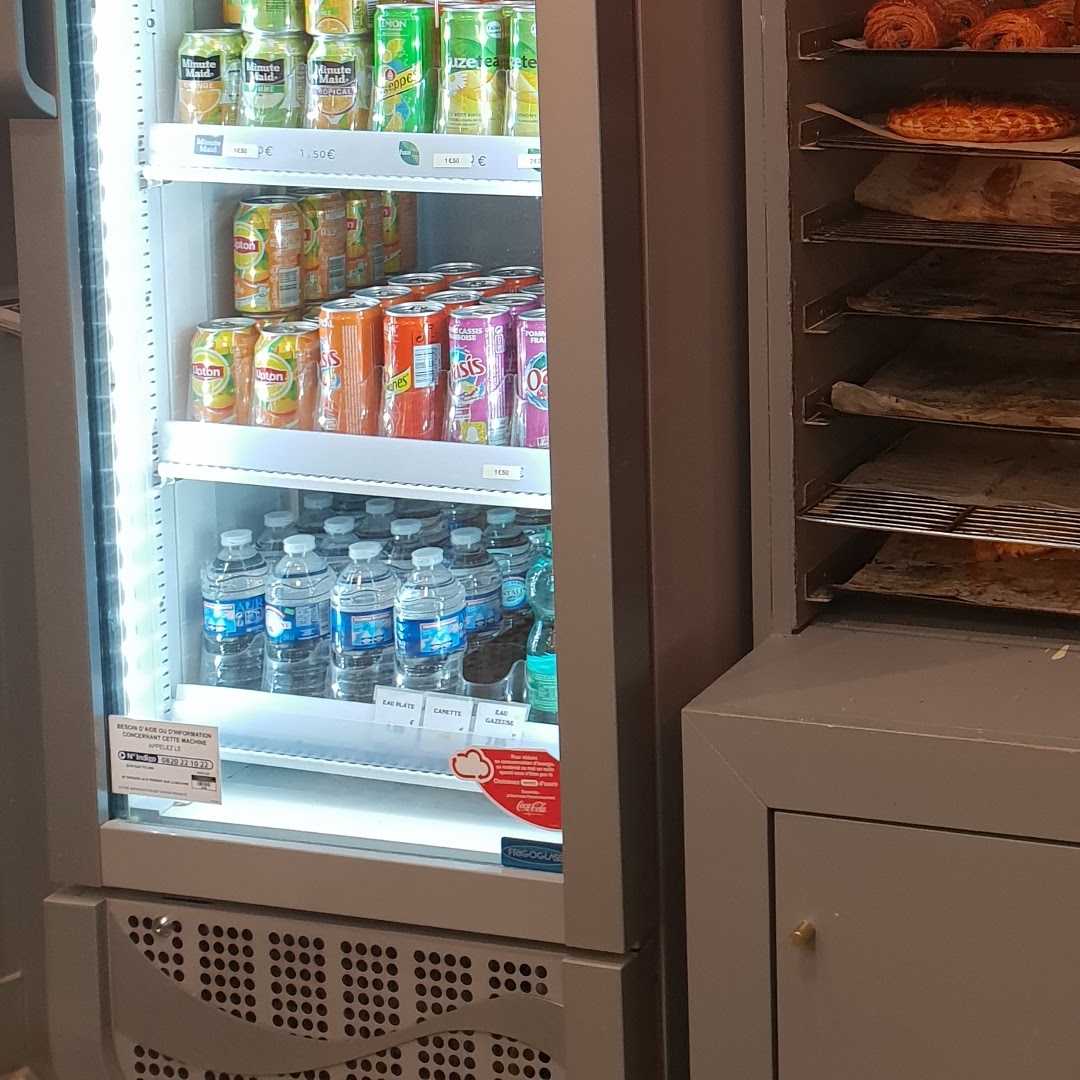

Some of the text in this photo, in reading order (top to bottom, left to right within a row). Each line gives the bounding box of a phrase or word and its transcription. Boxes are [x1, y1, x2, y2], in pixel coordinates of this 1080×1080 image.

[182, 58, 216, 69] Minute
[246, 61, 280, 72] Minute
[315, 64, 351, 74] Minute
[185, 68, 211, 78] Maid
[319, 74, 346, 85] Maid
[300, 149, 336, 160] 1.50€
[117, 723, 138, 731] BESOIN
[168, 728, 212, 739] D'INFORMATION
[122, 731, 207, 746] CONCERNANT CETTE MACHINE
[148, 743, 174, 751] APPELEZ
[136, 754, 157, 763] Indigo
[161, 757, 178, 765] 0820
[516, 800, 547, 813] Coca-Cola
